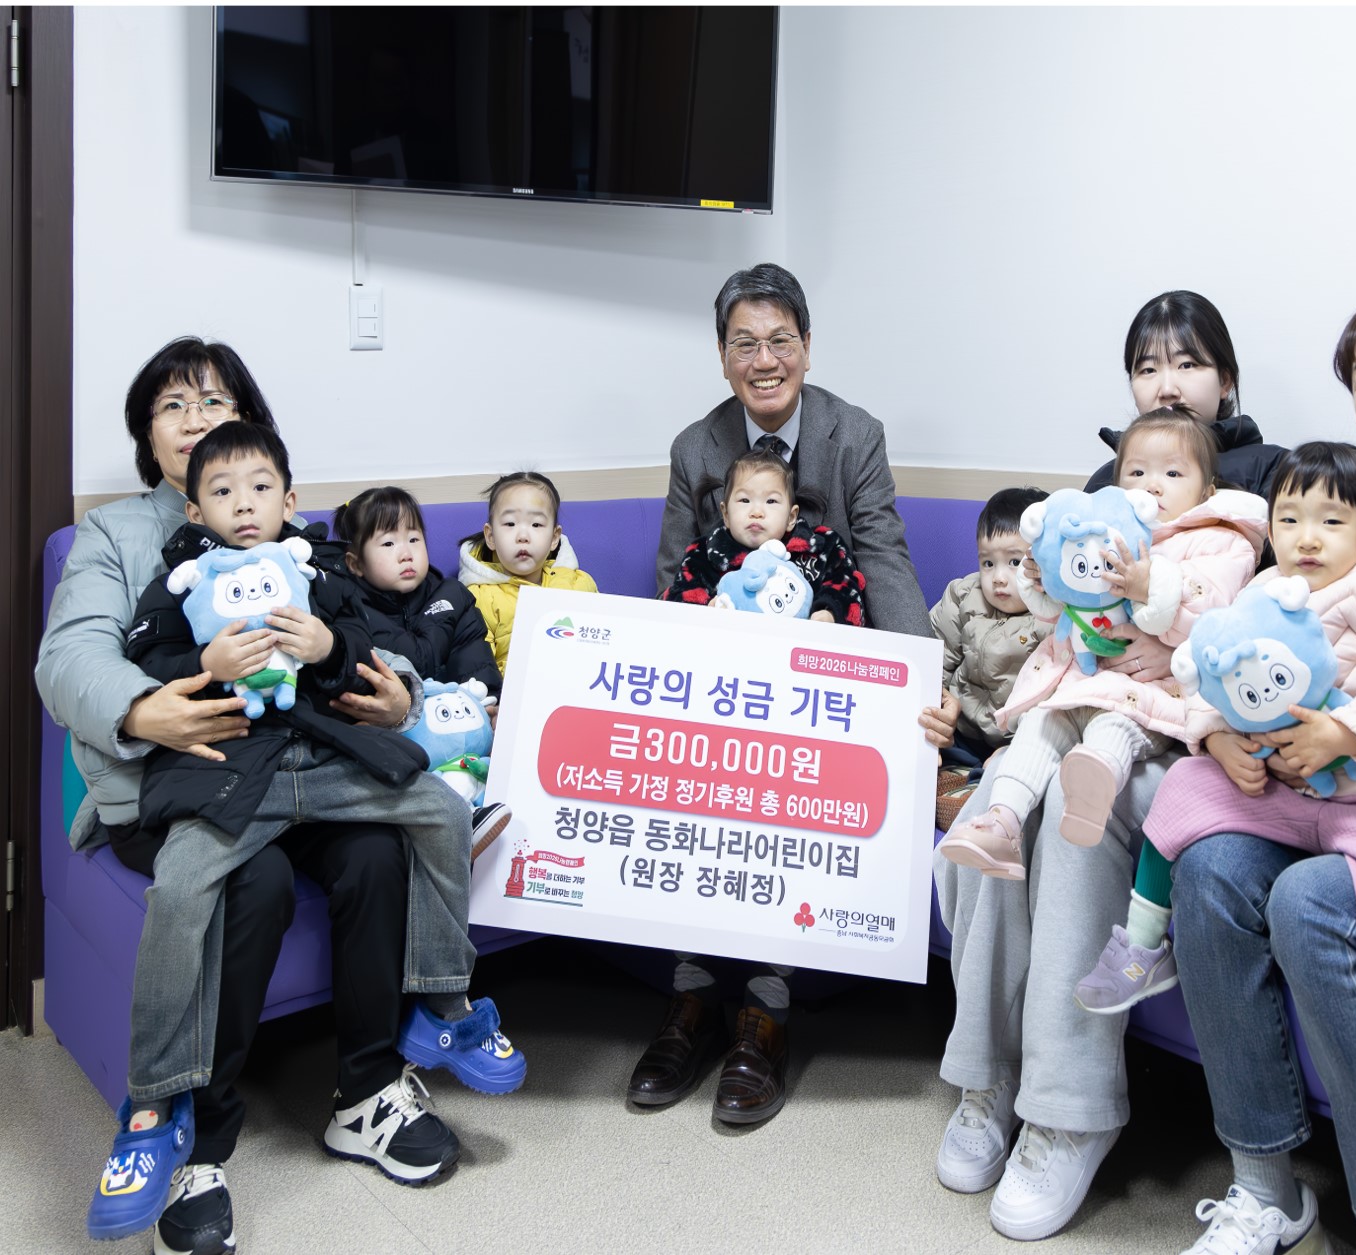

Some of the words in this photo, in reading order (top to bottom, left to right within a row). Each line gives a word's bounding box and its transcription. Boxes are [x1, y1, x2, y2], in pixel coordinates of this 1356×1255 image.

[578, 625, 612, 641] 청양군
[797, 653, 900, 682] 희망2026나눔캠페인
[589, 661, 693, 710] 사랑의
[707, 675, 775, 721] 성금
[790, 686, 857, 733] 기탁
[609, 722, 822, 785] 금300,000원
[556, 762, 624, 796] (저소득
[628, 772, 670, 802] 가정
[674, 777, 754, 813] 정기후원
[759, 789, 780, 817] 총
[786, 794, 869, 829] 600만원)
[554, 806, 636, 848] 청양읍
[644, 818, 861, 879] 동화나라어린이집
[526, 881, 551, 895] 기부로
[553, 873, 572, 884] 더하는
[572, 876, 585, 885] 기부
[619, 854, 685, 893] (원장
[696, 865, 787, 906] 장혜정)
[818, 907, 896, 933] 사랑의열매
